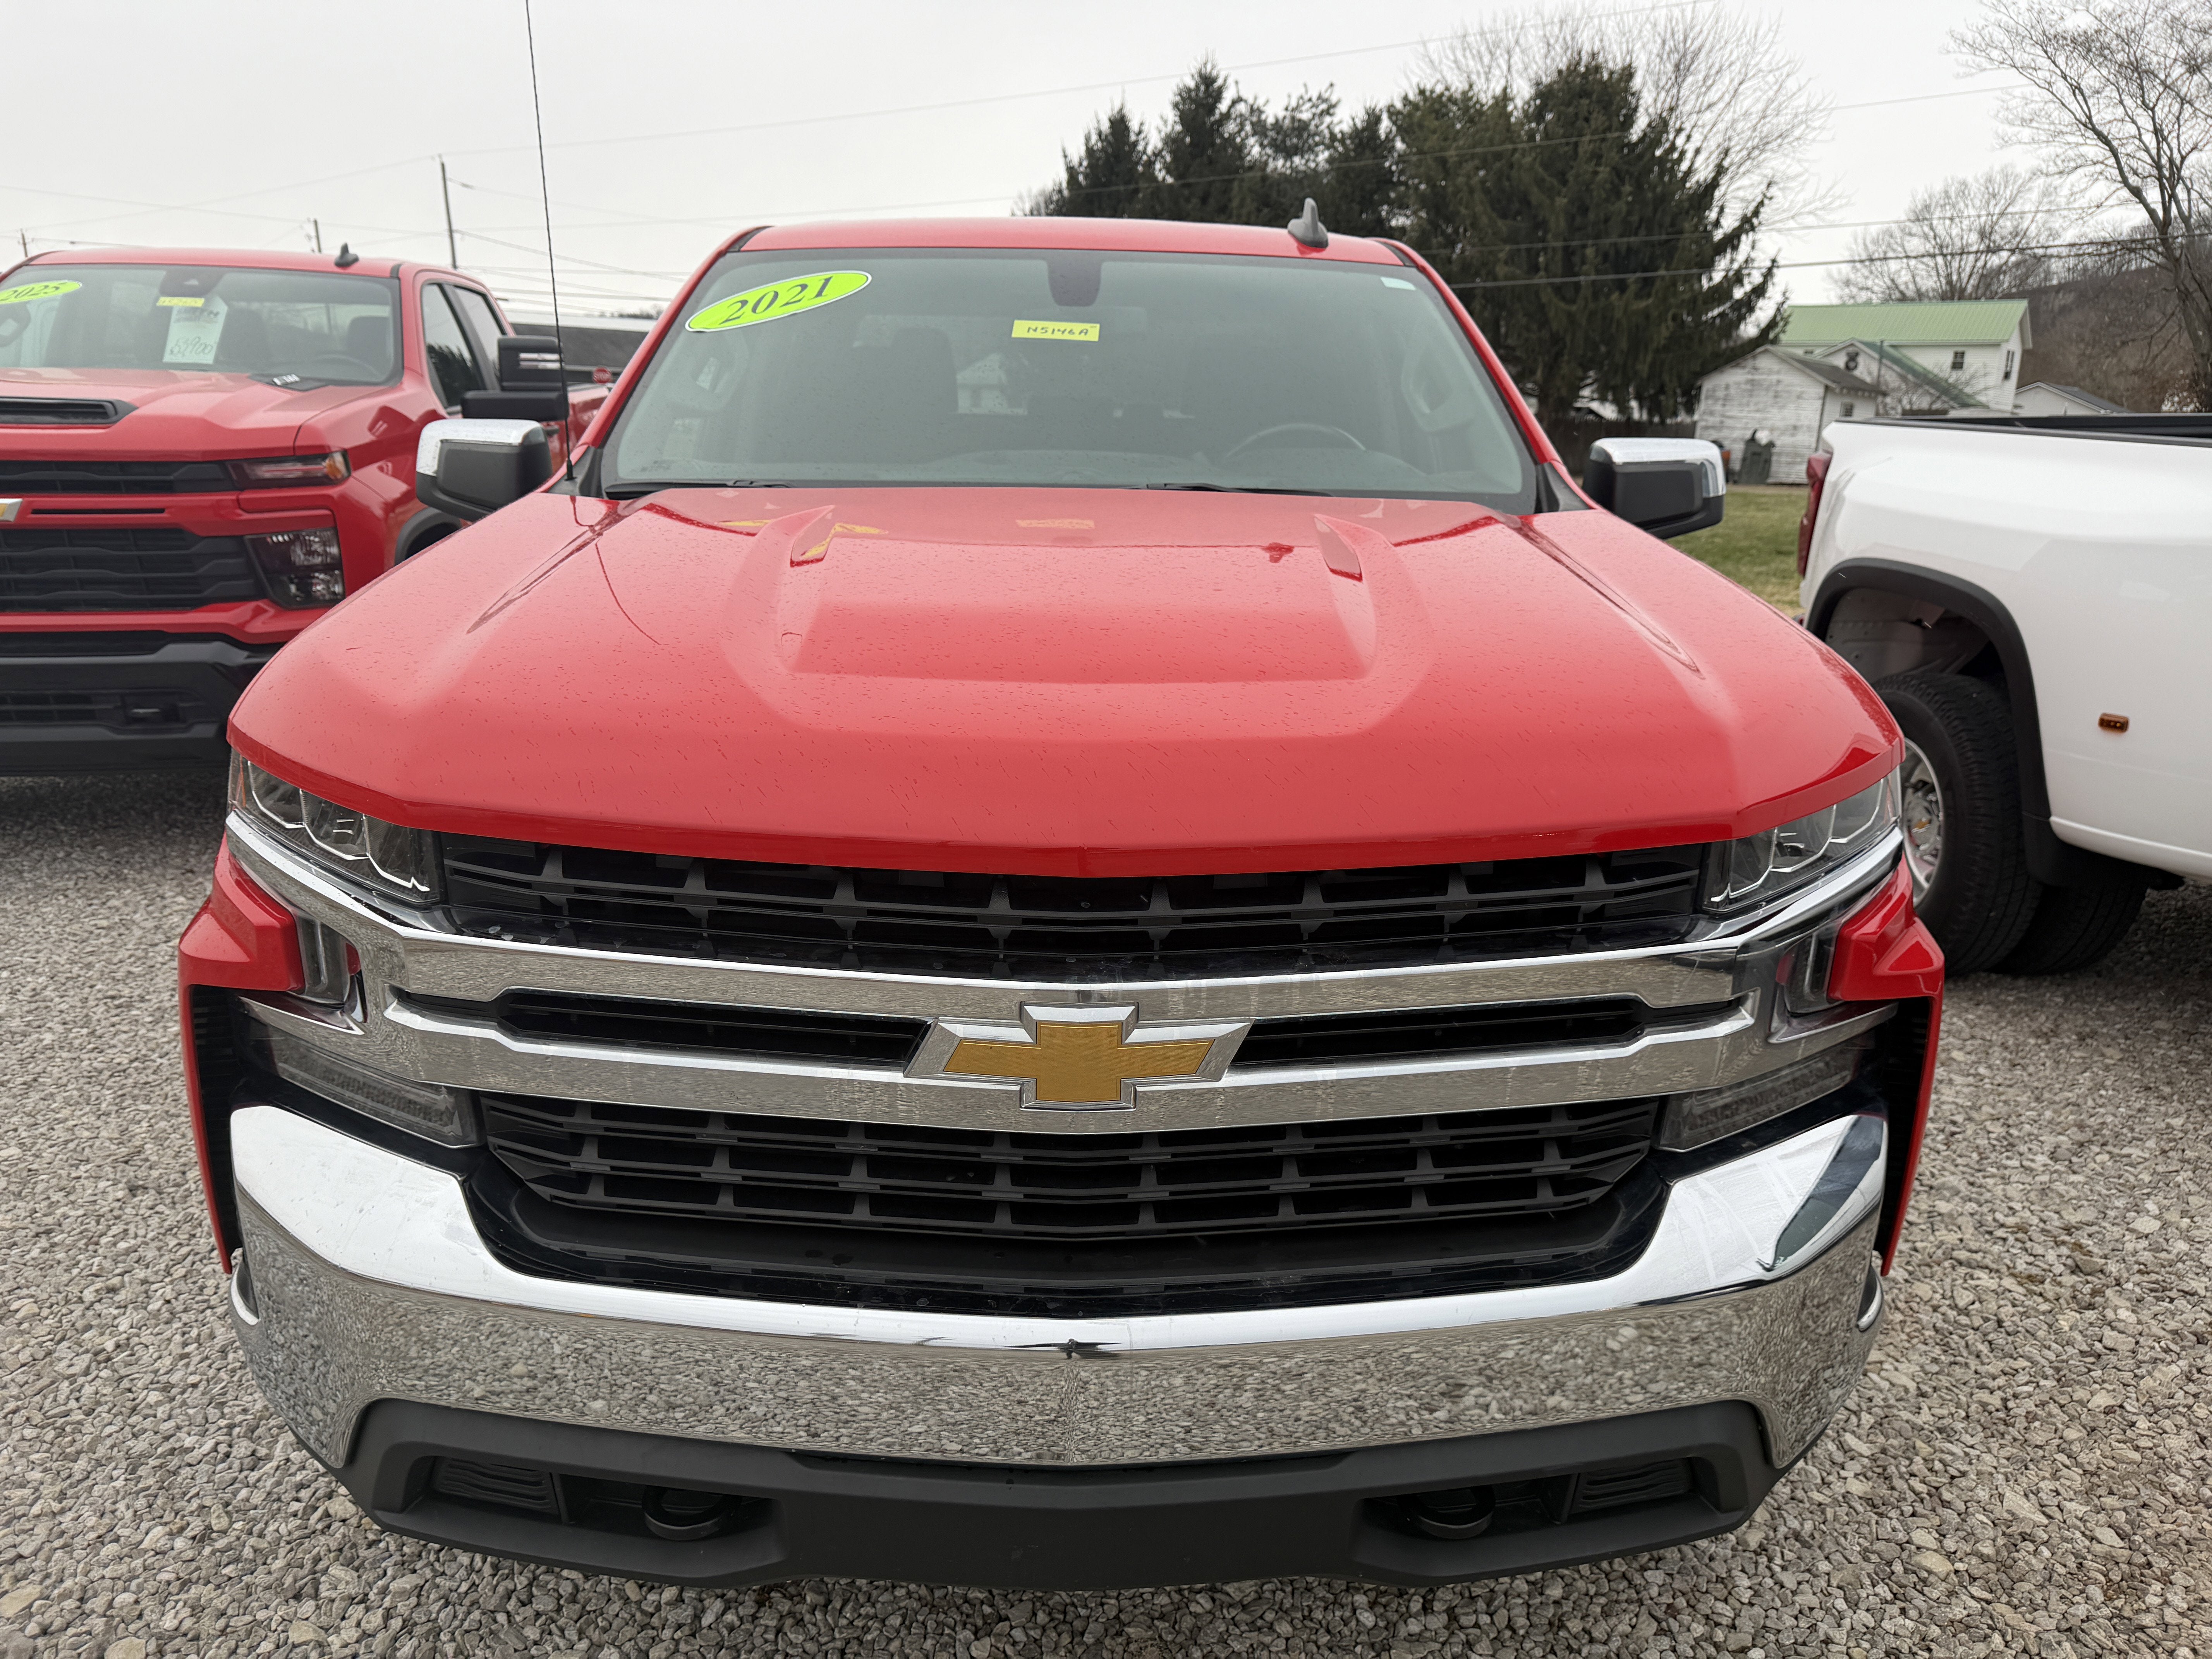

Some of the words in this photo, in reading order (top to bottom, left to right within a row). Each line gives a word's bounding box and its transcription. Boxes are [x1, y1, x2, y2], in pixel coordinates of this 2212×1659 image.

[0, 282, 67, 301] 2025
[718, 275, 834, 325] 2021
[1027, 326, 1089, 336] N5146A
